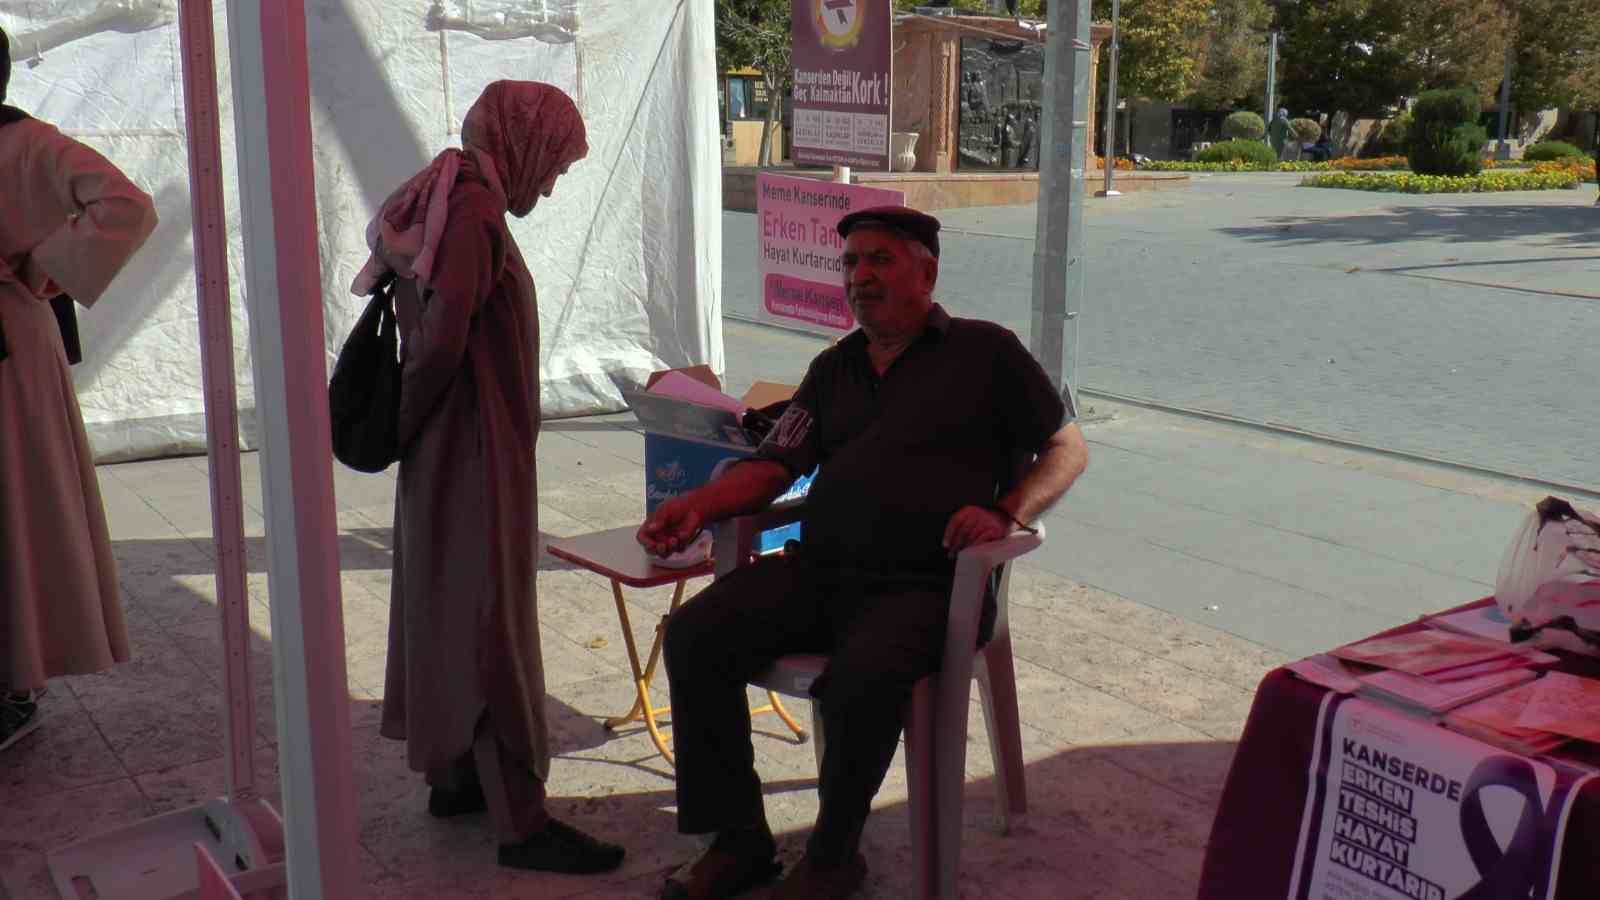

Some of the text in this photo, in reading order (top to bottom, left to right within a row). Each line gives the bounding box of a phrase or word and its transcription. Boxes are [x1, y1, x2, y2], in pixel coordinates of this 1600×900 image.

[852, 71, 880, 105] Kork
[763, 183, 850, 209] Meme Kanserinde
[763, 210, 806, 241] Erken
[763, 241, 790, 264] Hayat
[1342, 761, 1411, 811] ERKEN
[1343, 737, 1462, 802] KANSERDE
[1336, 814, 1408, 865] HAYAT
